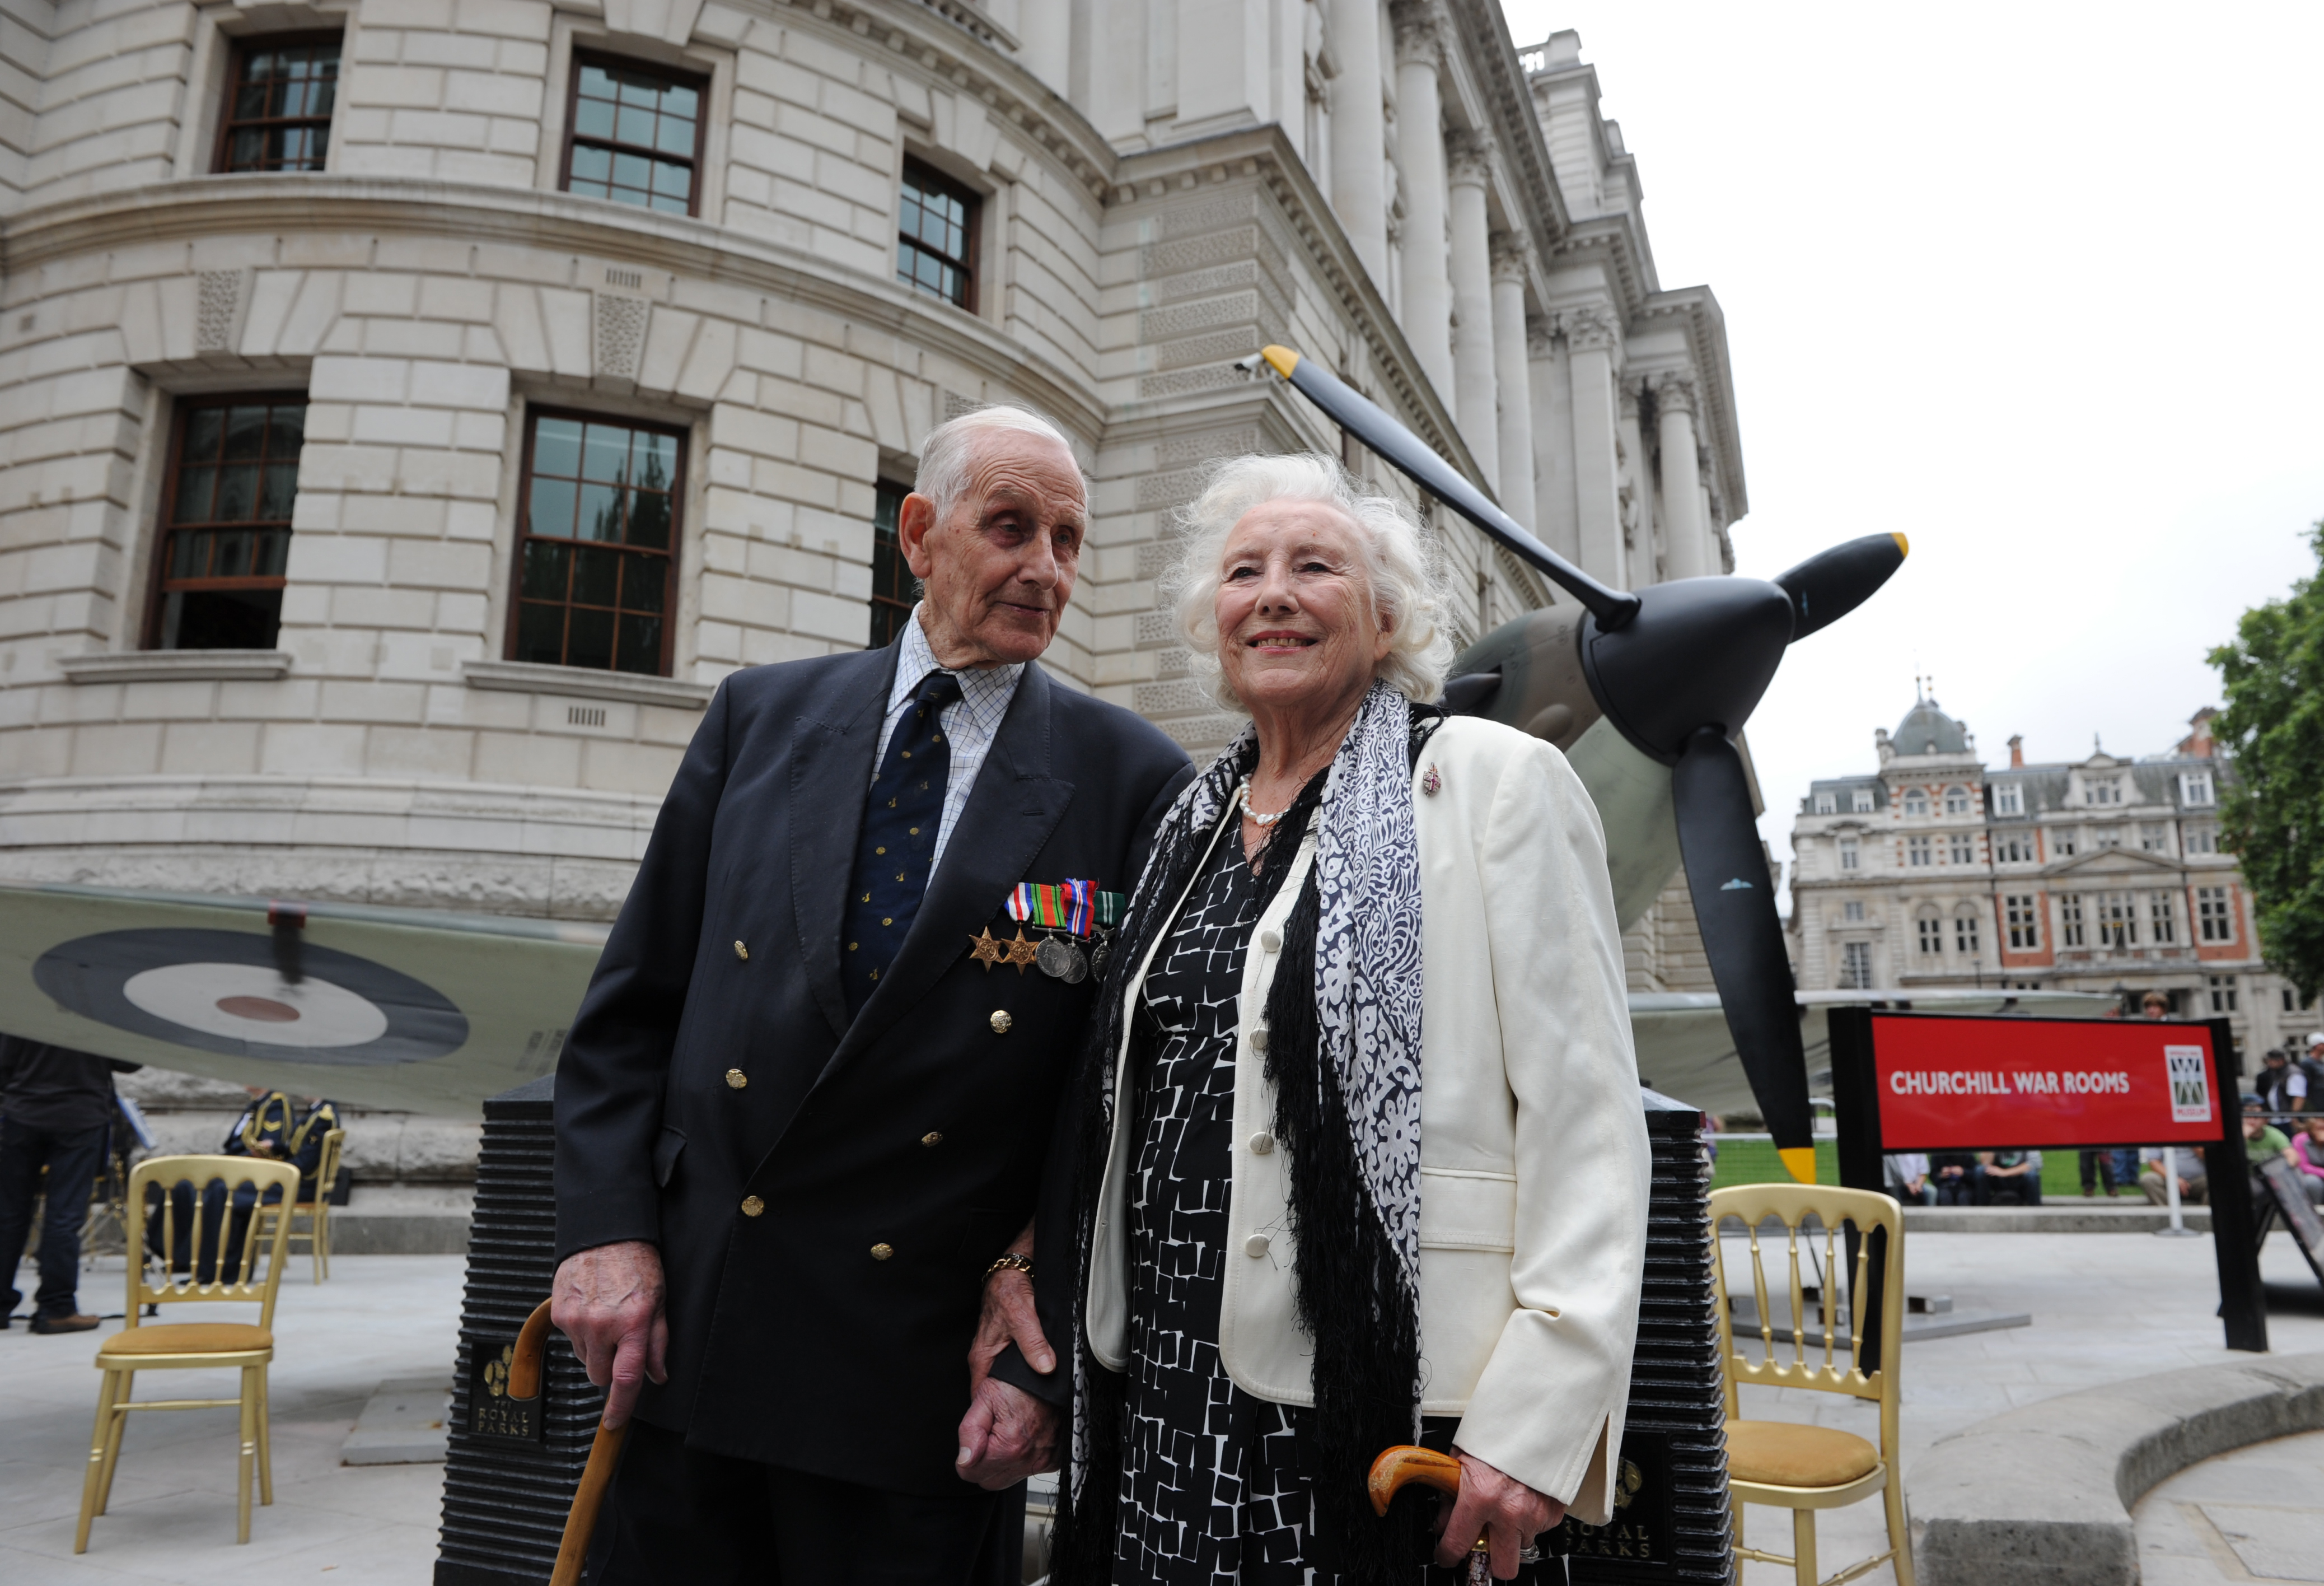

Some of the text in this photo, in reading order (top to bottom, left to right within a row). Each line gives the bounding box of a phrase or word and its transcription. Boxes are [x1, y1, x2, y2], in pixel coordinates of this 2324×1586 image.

[1890, 1070, 2130, 1095] CHURCHILL WAR ROOMS
[479, 1408, 529, 1423] ROYAL
[478, 1421, 529, 1436] PARKS
